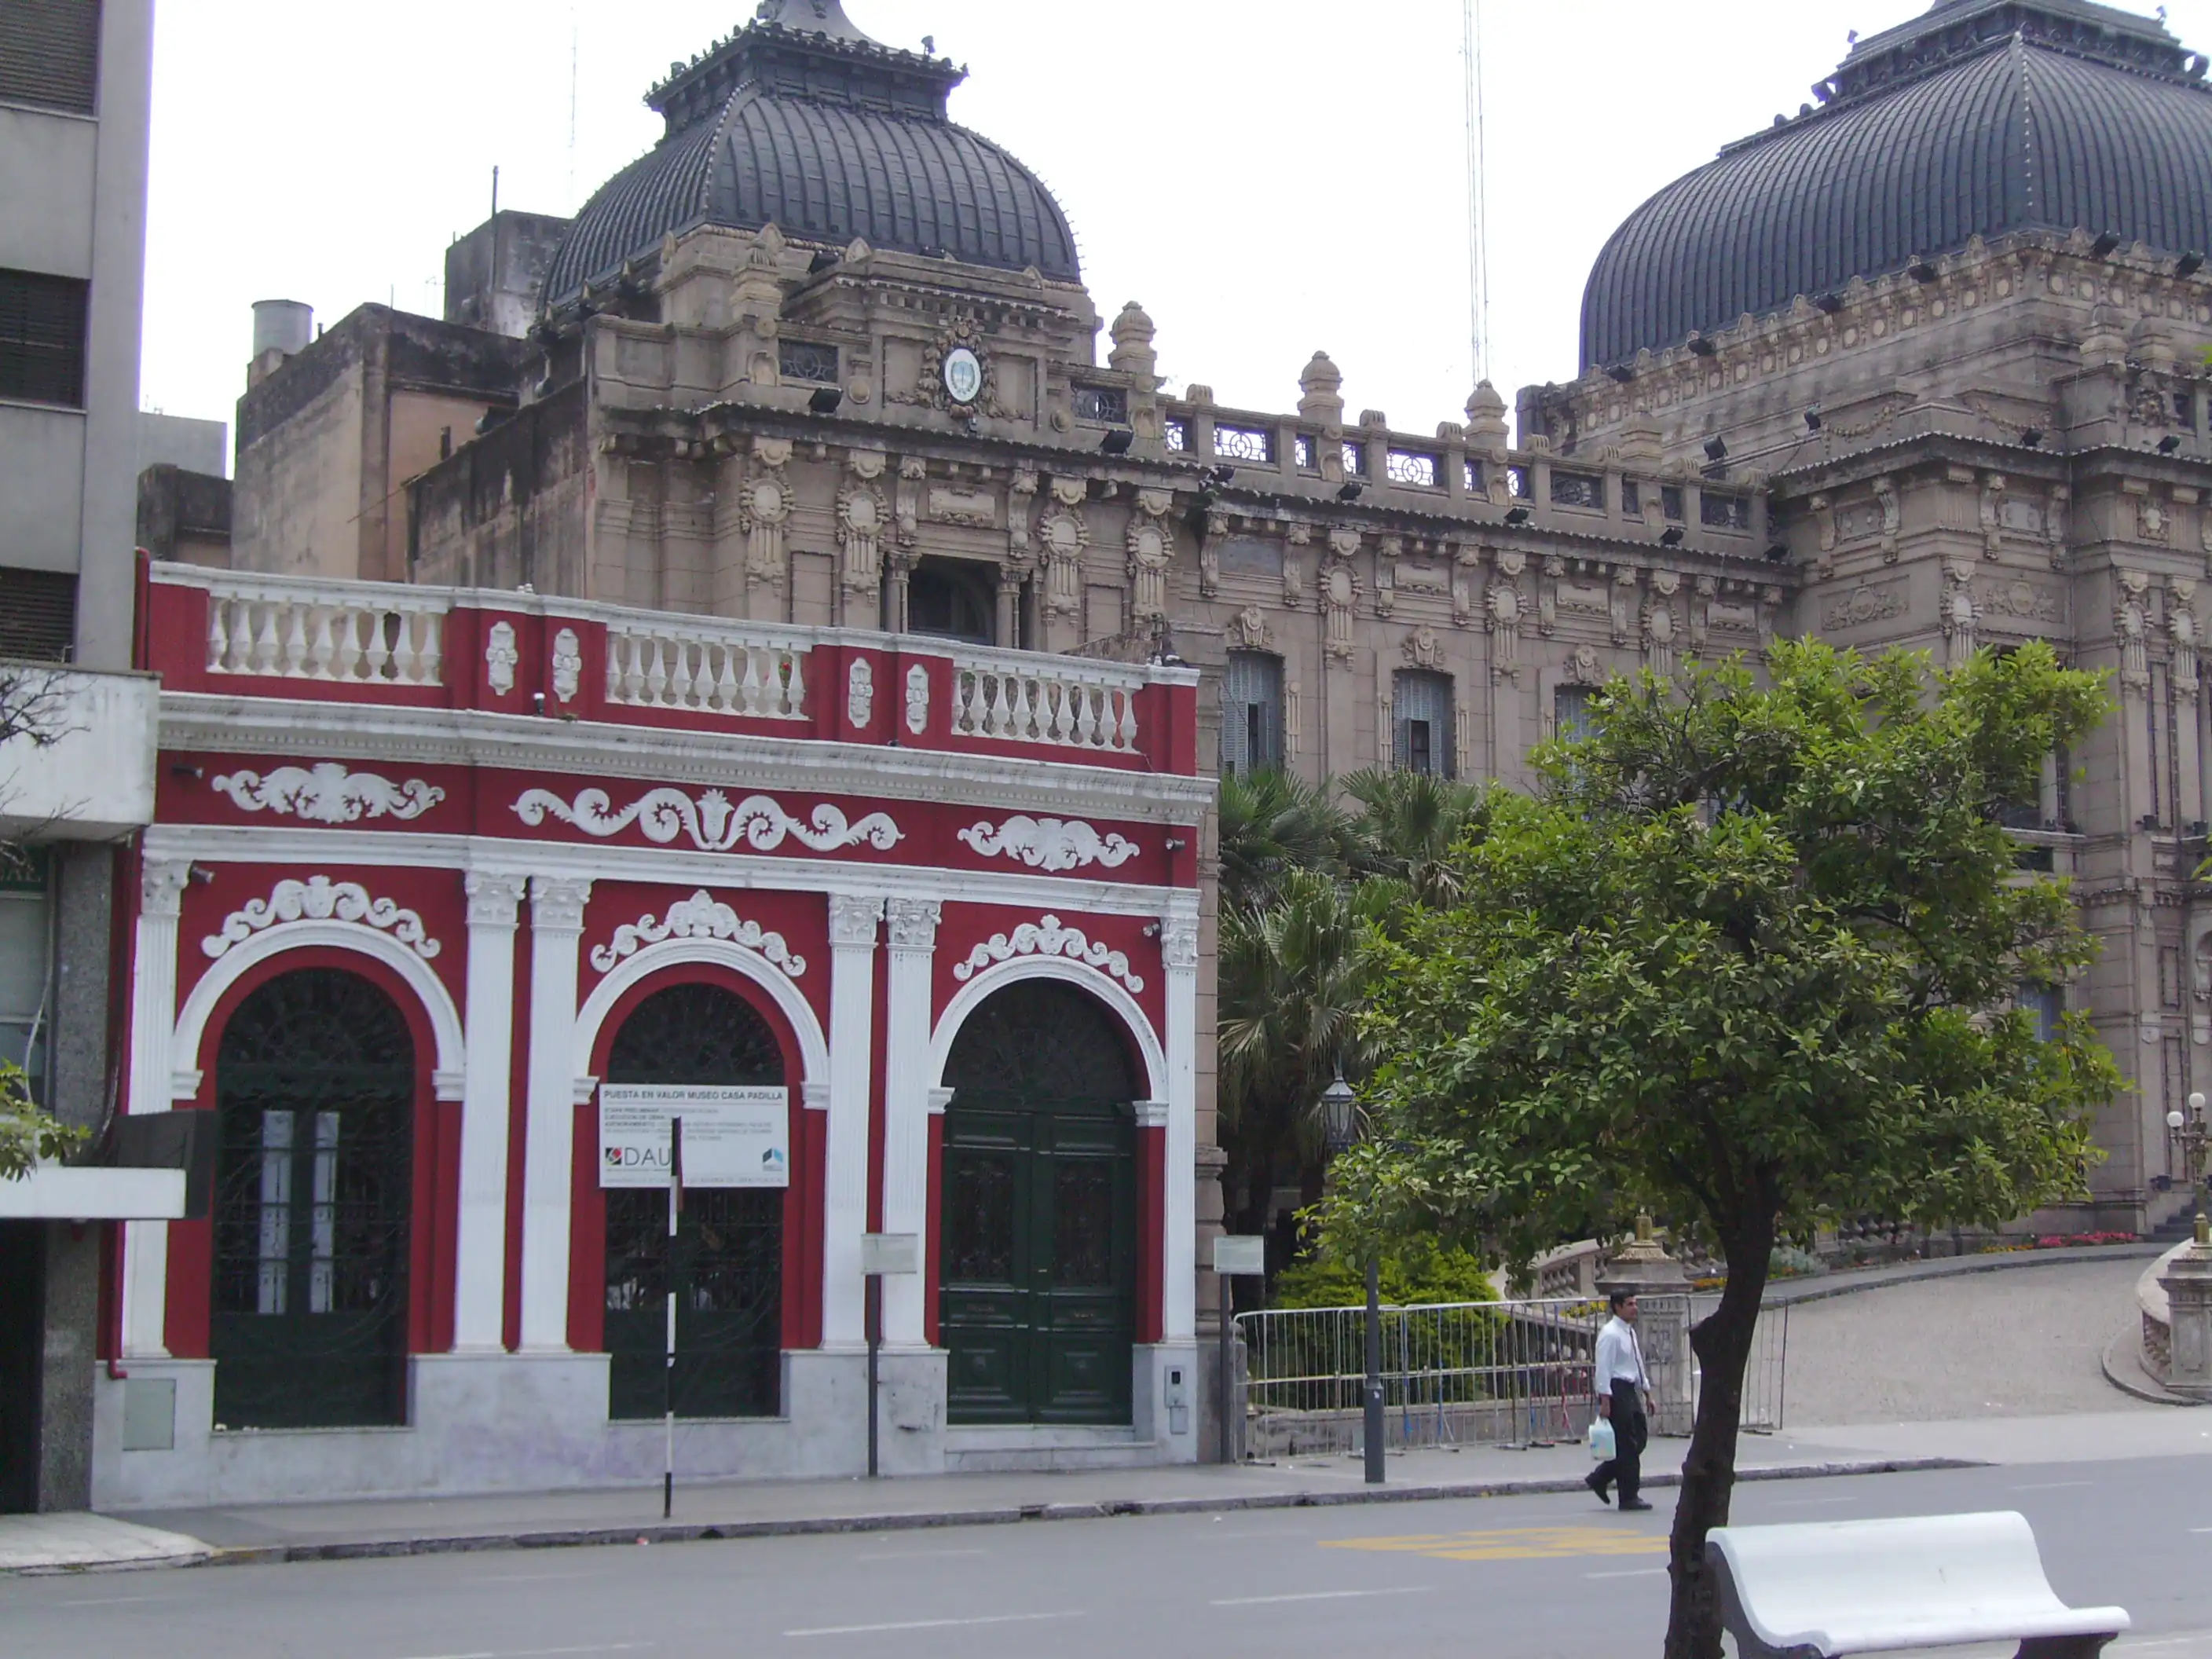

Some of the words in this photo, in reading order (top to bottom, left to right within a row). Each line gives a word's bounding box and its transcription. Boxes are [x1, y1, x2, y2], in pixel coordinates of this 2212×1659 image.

[604, 1090, 639, 1099] PUESTA
[641, 1090, 654, 1099] EN
[657, 1090, 686, 1100] VALOR
[687, 1090, 720, 1100] MUSEO
[721, 1091, 745, 1100] CASA
[747, 1091, 782, 1101] PADILLA
[624, 1147, 671, 1166] DAU
